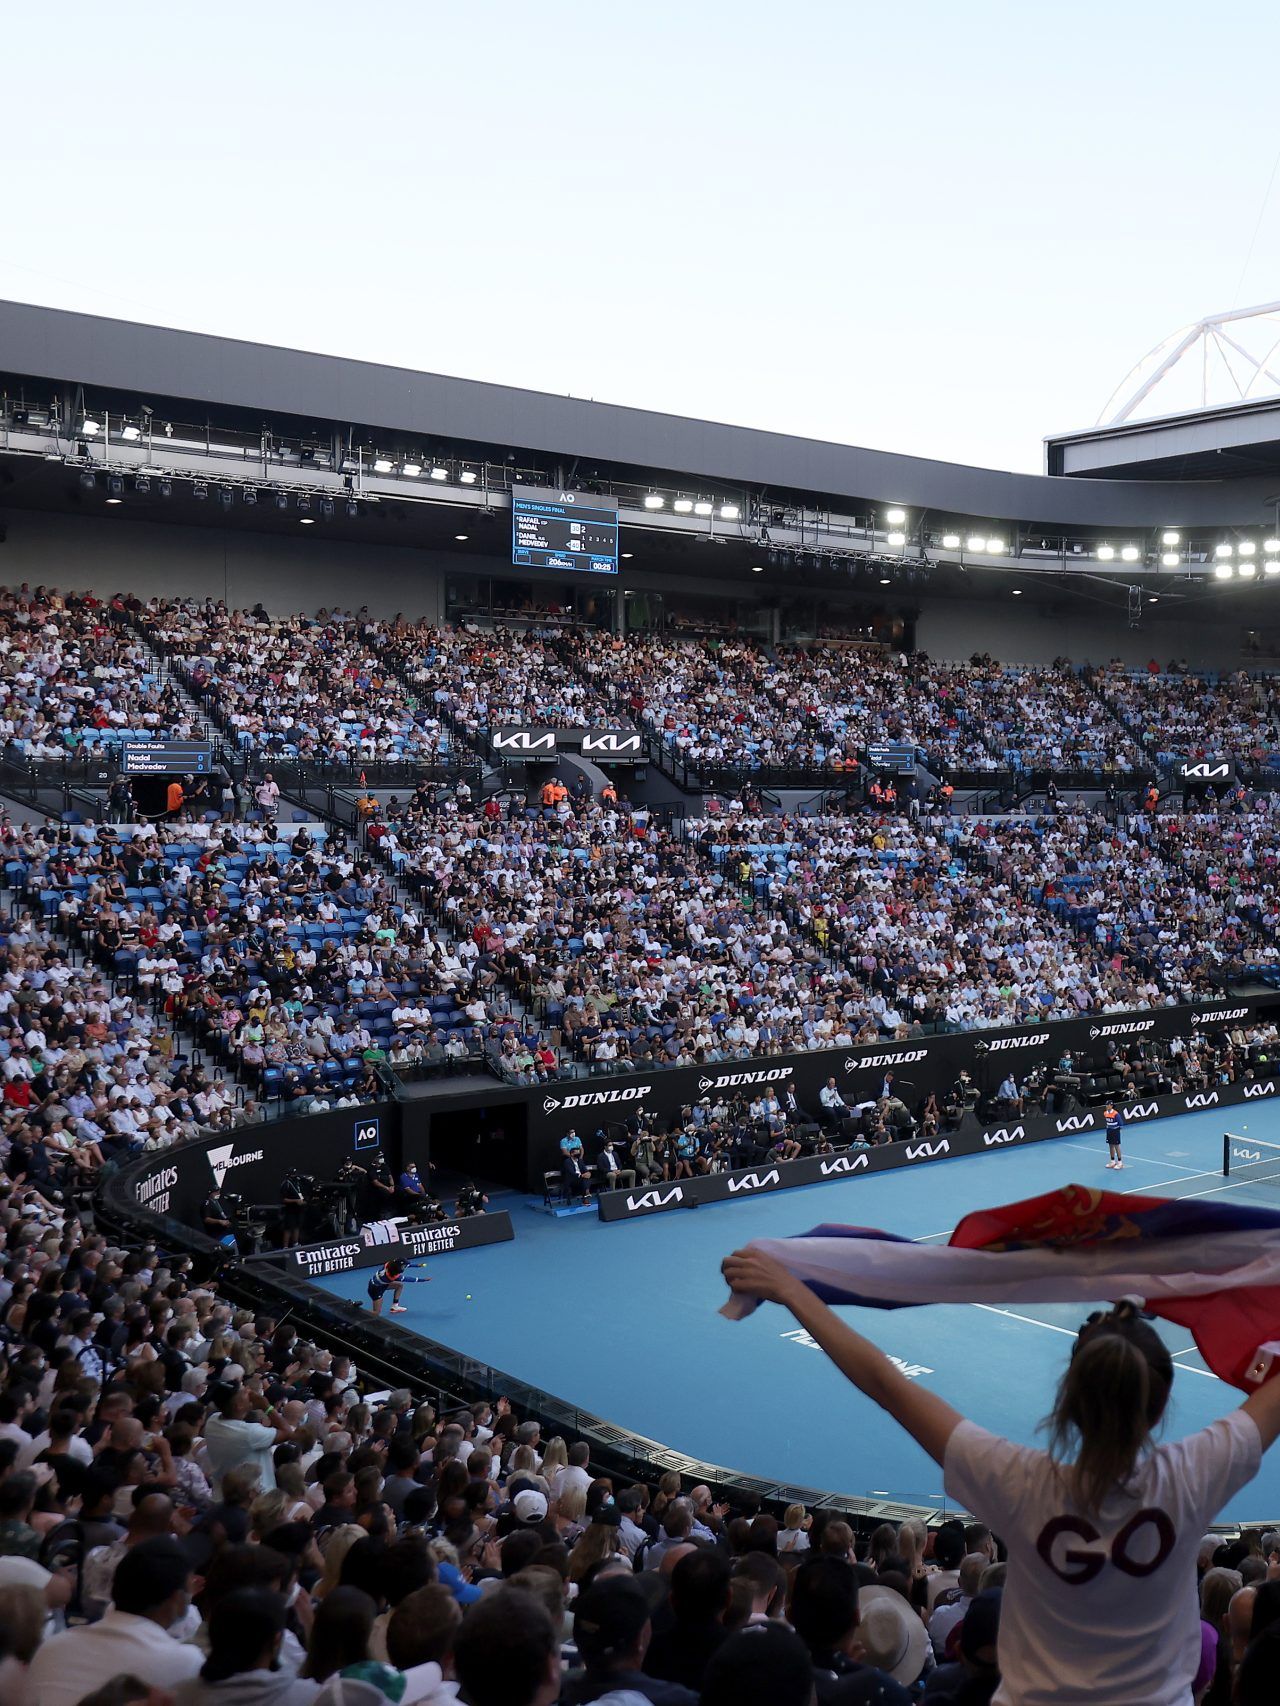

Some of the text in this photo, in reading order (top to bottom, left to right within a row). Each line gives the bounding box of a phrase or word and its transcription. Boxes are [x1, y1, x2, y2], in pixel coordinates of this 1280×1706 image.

[560, 493, 575, 502] AO
[519, 516, 540, 524] RAFAEL
[493, 731, 556, 749] KIA
[582, 734, 641, 750] KIA
[1181, 763, 1229, 777] KIA
[1200, 1008, 1249, 1023] DUNLOP
[1100, 1020, 1155, 1036] DUNLOP
[989, 1033, 1050, 1051] DUNLOP
[858, 1049, 928, 1069] DUNLOP
[714, 1067, 794, 1088] DUNLOP
[561, 1086, 651, 1109] DUNLOP
[1243, 1081, 1276, 1099] KIA
[1185, 1091, 1219, 1108] KIA
[1123, 1101, 1160, 1120] KIA
[1056, 1113, 1095, 1133] KIA
[357, 1126, 377, 1141] AO
[983, 1125, 1025, 1146] KIA
[905, 1139, 951, 1160] KIA
[1233, 1147, 1261, 1161] KIA
[820, 1153, 869, 1175] KIA
[135, 1165, 178, 1203] Emirates
[728, 1170, 780, 1192] KIA
[626, 1187, 684, 1211] KIA
[401, 1225, 461, 1246] Emirates
[295, 1243, 361, 1265] Emirates
[414, 1238, 455, 1254] FLY BETTER
[309, 1257, 354, 1275] FLY BETTER
[1036, 1507, 1177, 1585] GO
